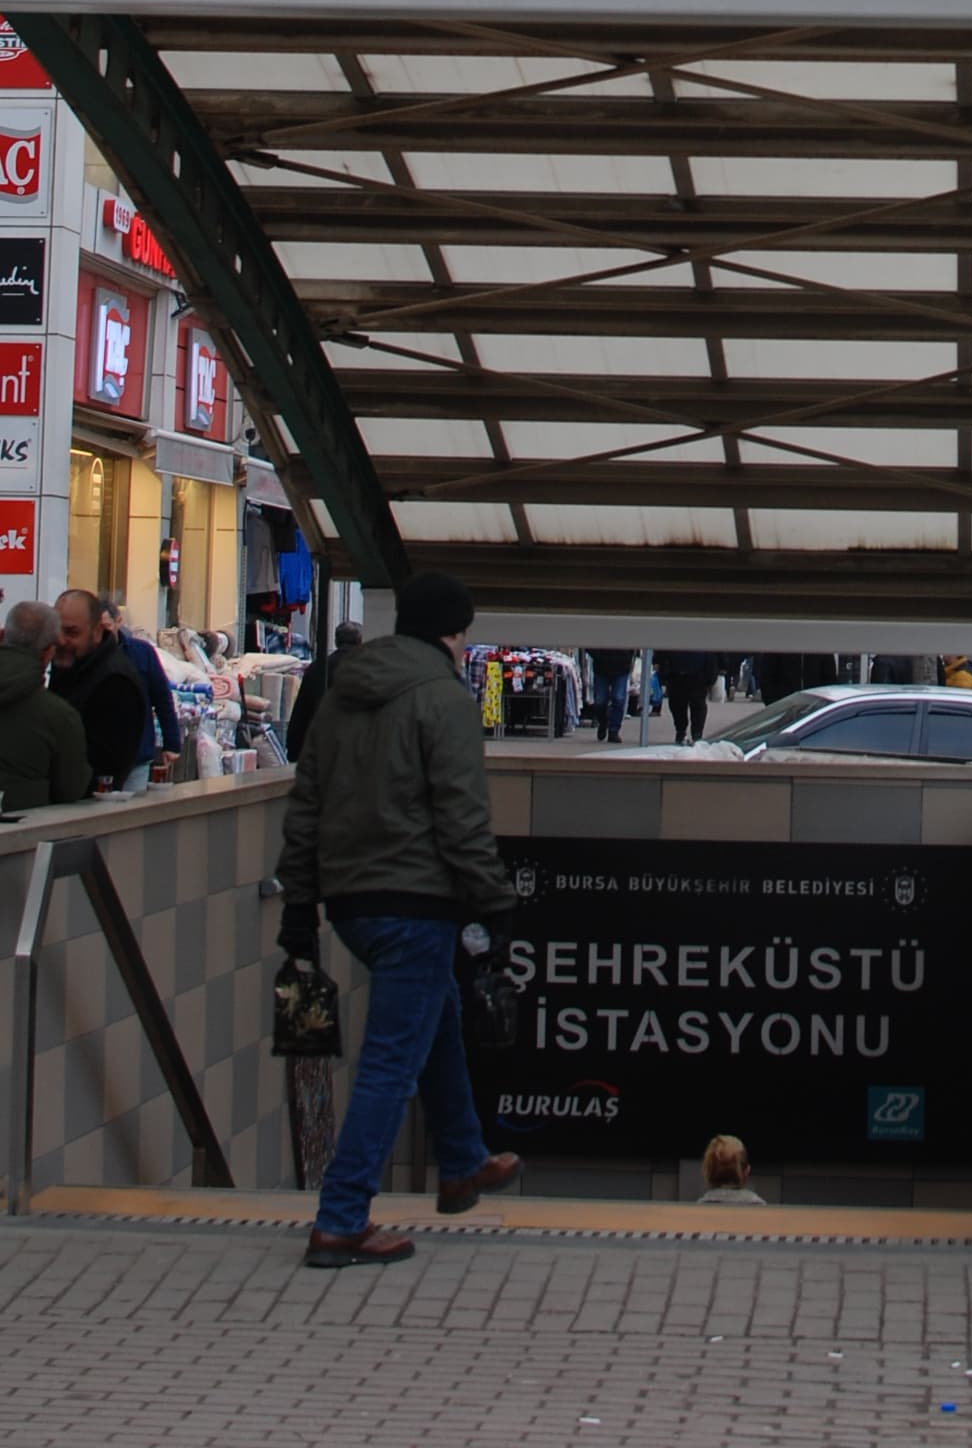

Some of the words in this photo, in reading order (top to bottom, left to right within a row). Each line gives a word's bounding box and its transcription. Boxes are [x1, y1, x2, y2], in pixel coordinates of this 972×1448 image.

[116, 205, 130, 229] 1969
[555, 874, 620, 892] BURSA
[628, 872, 751, 896] BÜYÜKŞEHİR
[762, 875, 876, 897] BELEDİYESİ
[504, 937, 926, 993] ŞEHREKÜSTÜ
[536, 996, 891, 1058] İSTASYONU
[497, 1093, 620, 1124] BURULAŞ
